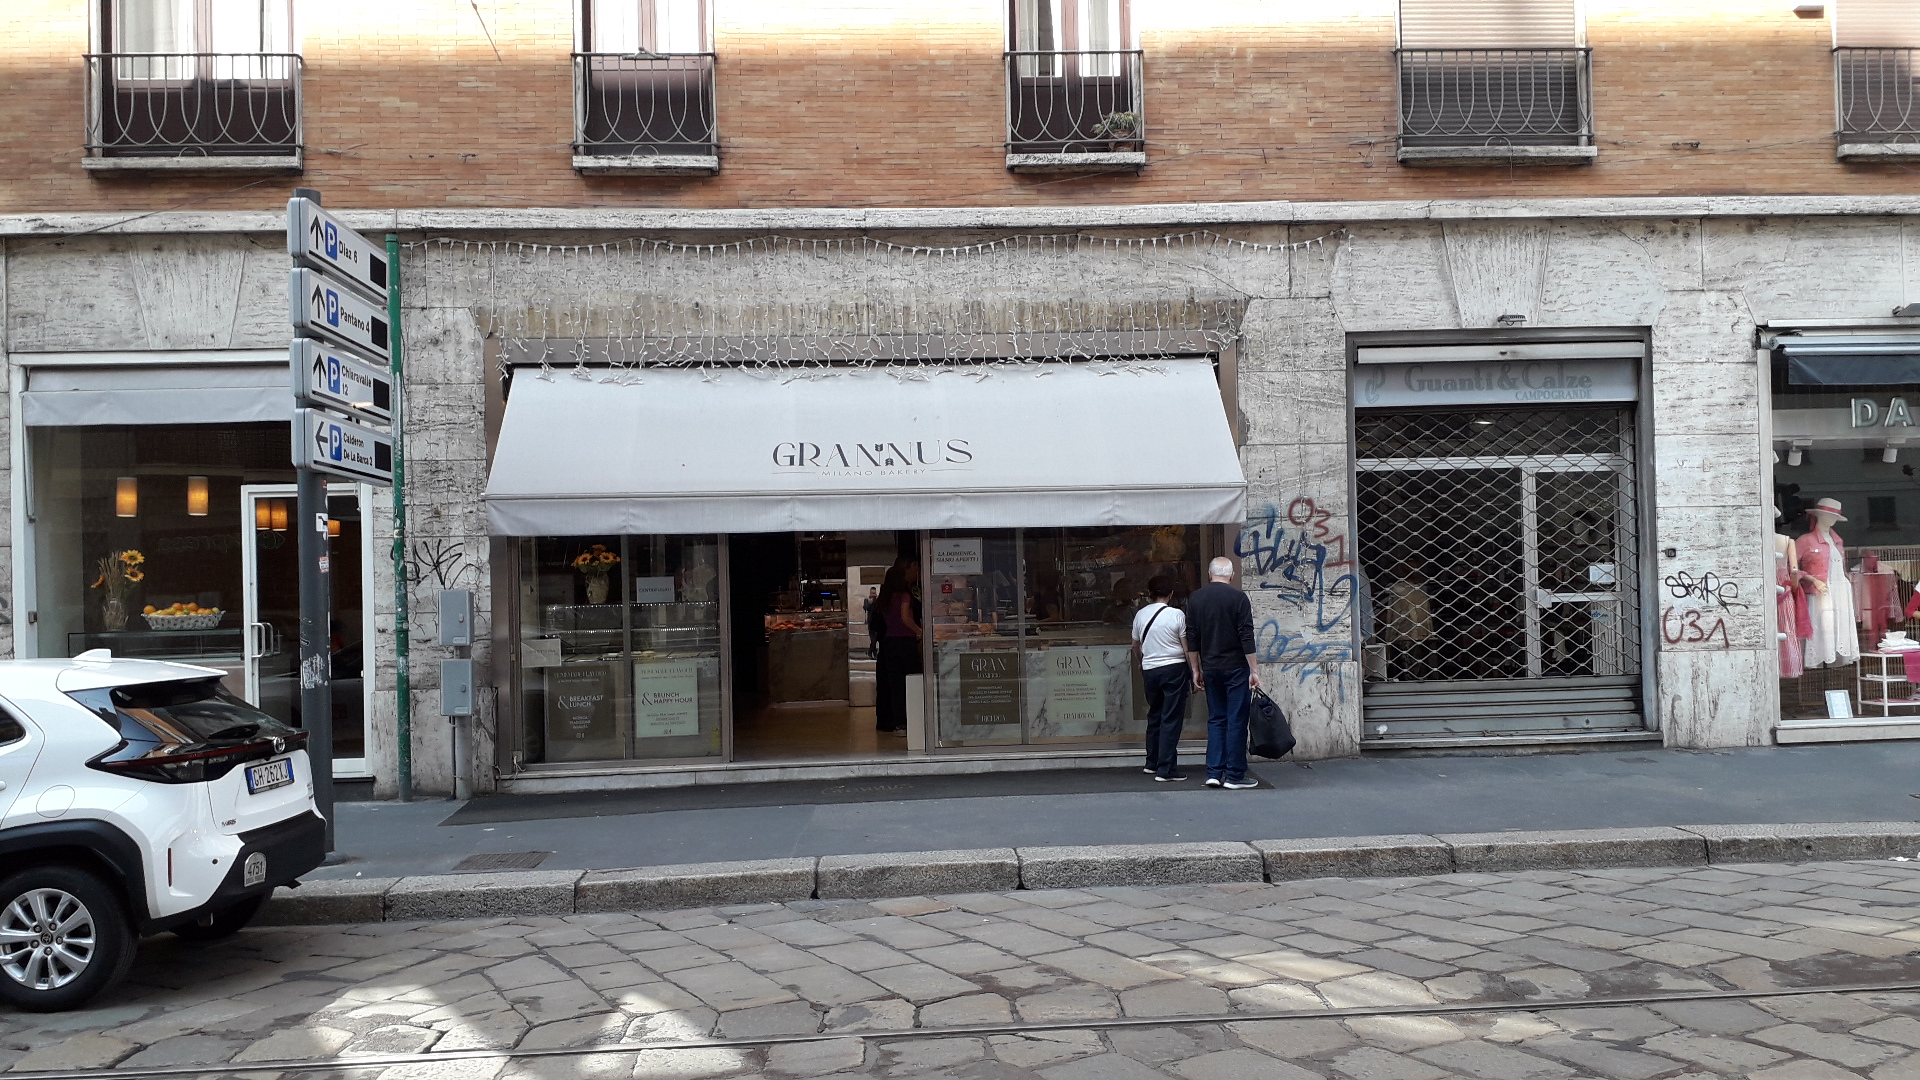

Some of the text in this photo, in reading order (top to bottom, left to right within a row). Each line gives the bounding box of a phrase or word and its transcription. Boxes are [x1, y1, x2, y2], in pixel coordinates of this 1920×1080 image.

[339, 238, 352, 261] Diaz
[353, 250, 358, 264] 6
[340, 306, 365, 332] Pantano
[365, 320, 370, 334] 4
[341, 364, 372, 389] Chiaravalle
[1405, 360, 1593, 393] Guanti & Calze
[342, 383, 348, 396] 12
[343, 431, 364, 448] Calderon
[343, 448, 350, 459] De
[350, 450, 356, 460] La
[356, 451, 369, 465] Barca
[772, 438, 973, 468] GRANNUS
[880, 468, 926, 476] BAKERY
[569, 694, 603, 702] BREAKFAST
[248, 860, 263, 876] 4751
